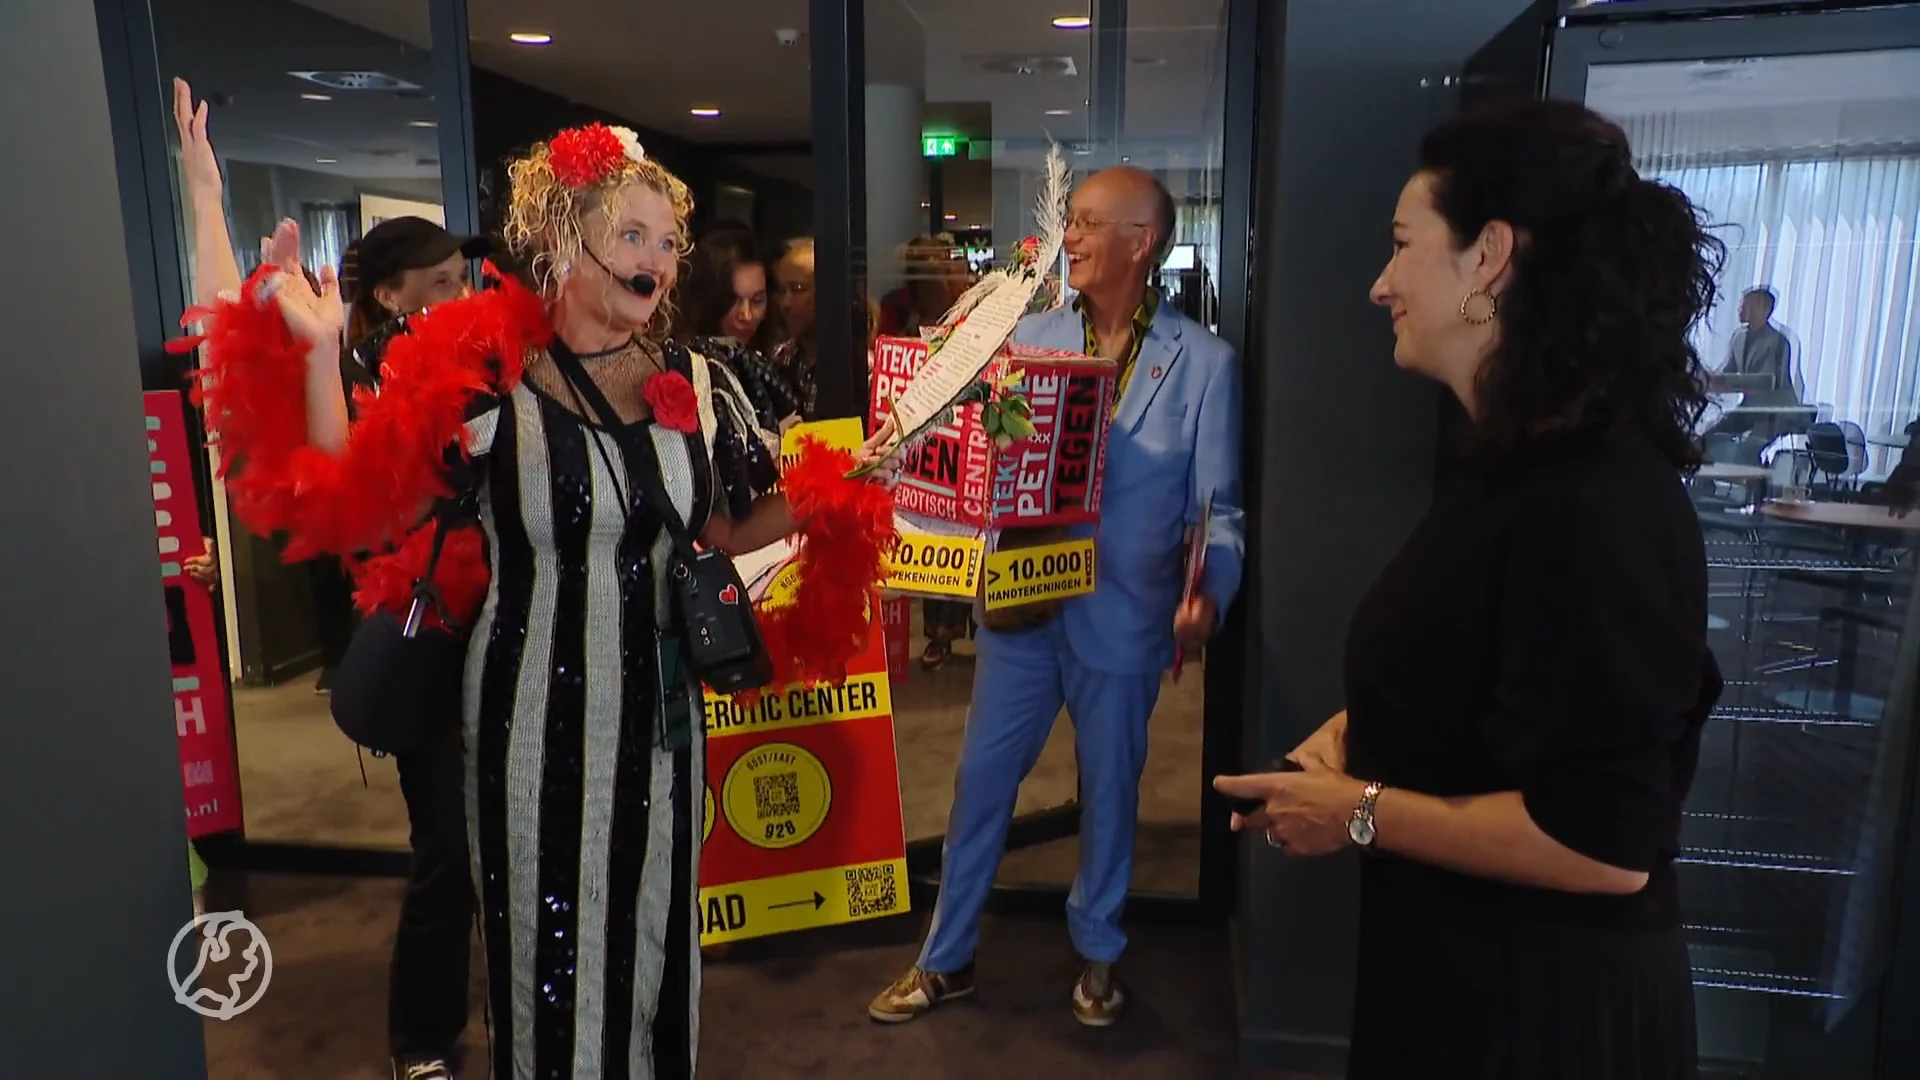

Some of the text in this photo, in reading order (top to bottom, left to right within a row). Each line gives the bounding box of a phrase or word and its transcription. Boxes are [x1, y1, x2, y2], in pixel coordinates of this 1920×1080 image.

[1053, 374, 1097, 514] TEGEN
[1008, 551, 1082, 583] 10.000
[987, 578, 1082, 603] HANDTEKENINGEN
[704, 681, 878, 731] EROTIC CENTER
